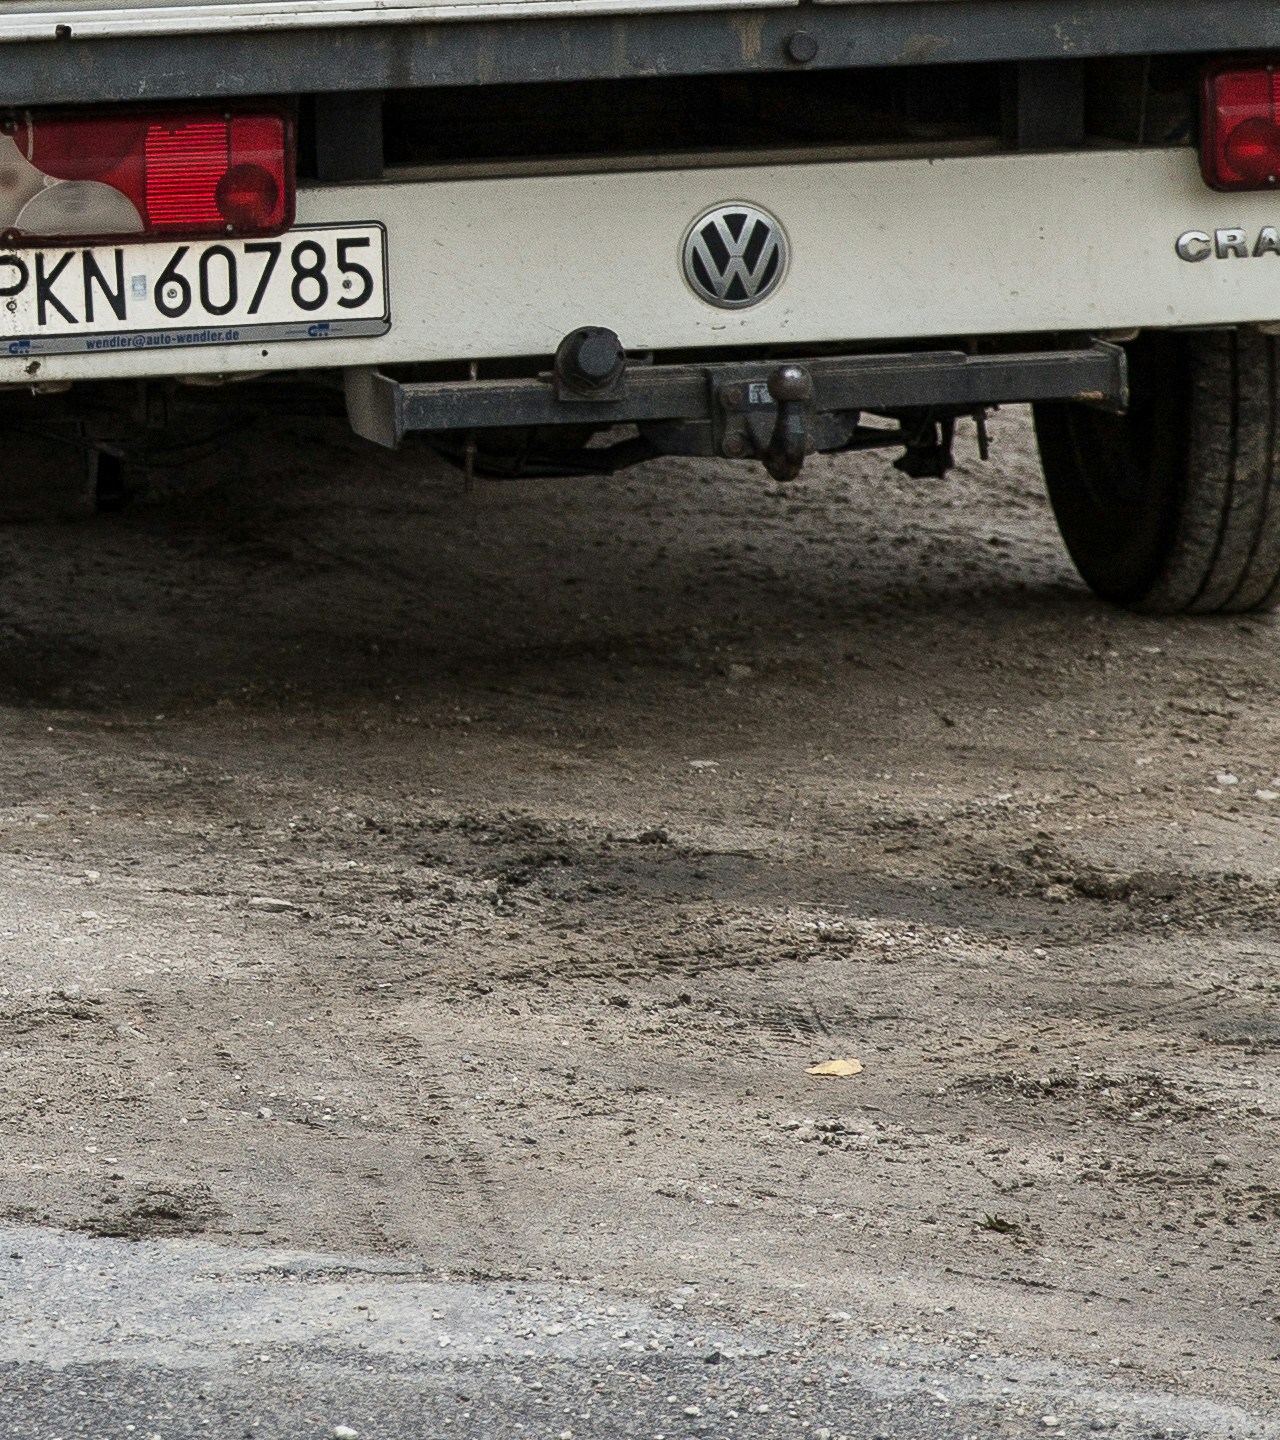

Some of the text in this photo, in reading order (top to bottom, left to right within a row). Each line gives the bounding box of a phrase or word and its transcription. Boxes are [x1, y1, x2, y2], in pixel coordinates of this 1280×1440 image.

[684, 205, 786, 310] VW
[1175, 226, 1280, 263] CRA
[154, 237, 374, 318] 60785
[86, 328, 240, 349] wendler@auto-wendler.de
